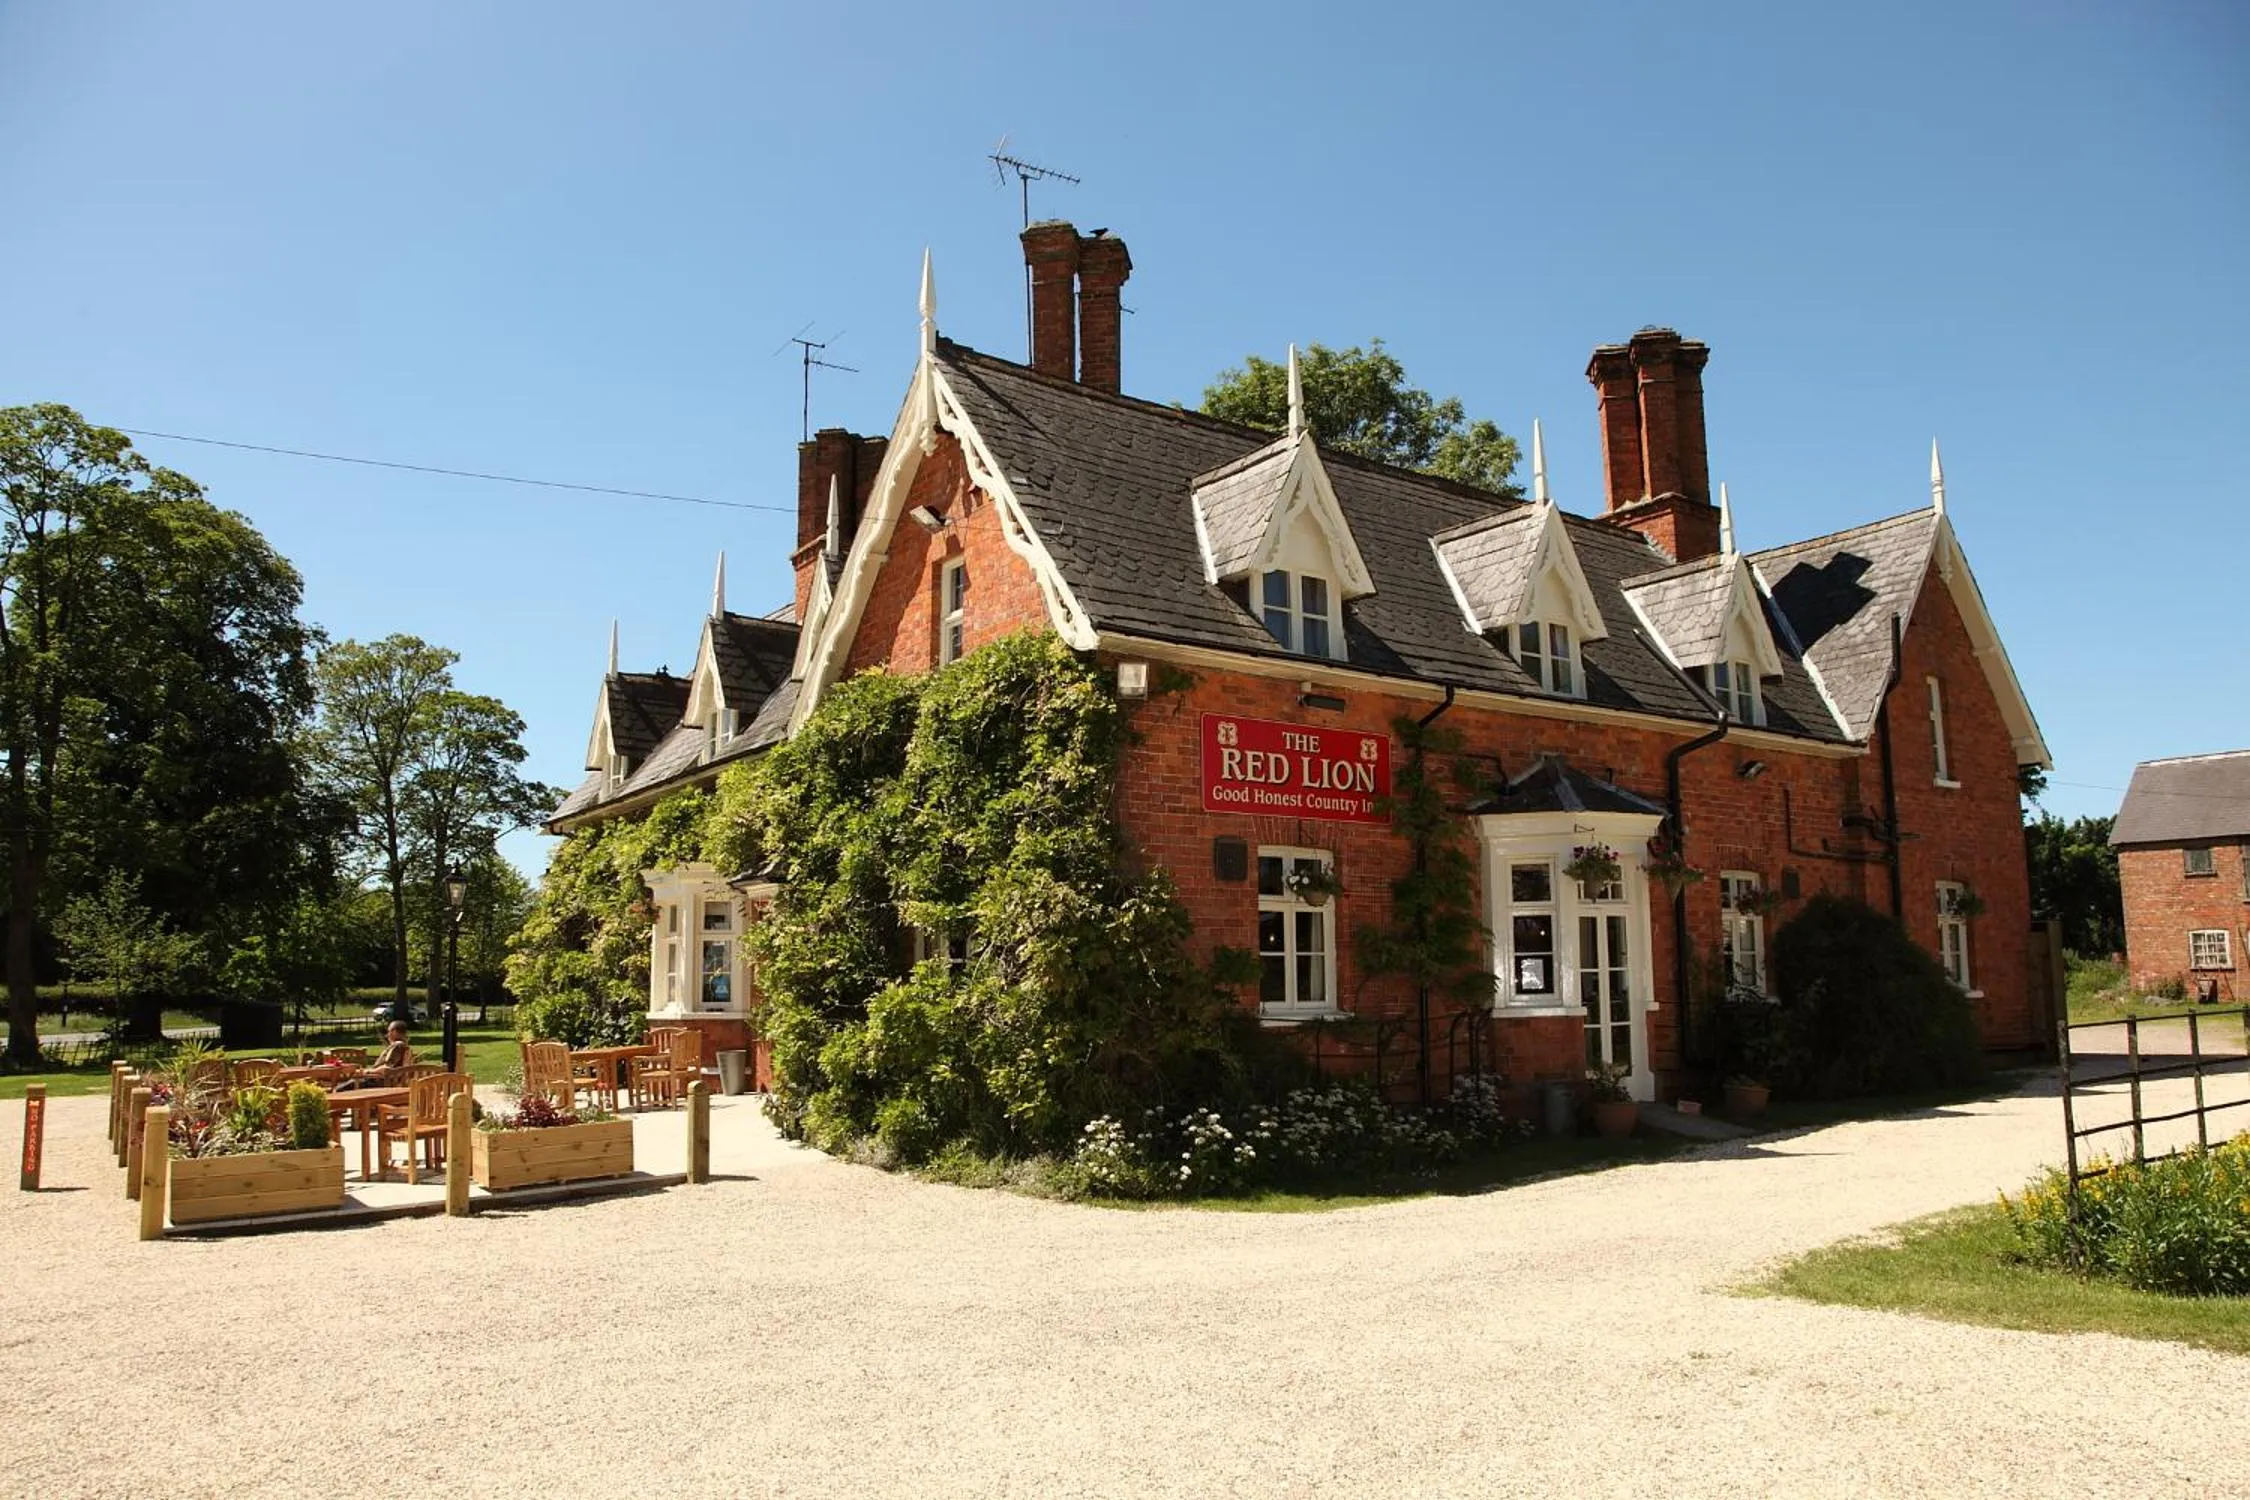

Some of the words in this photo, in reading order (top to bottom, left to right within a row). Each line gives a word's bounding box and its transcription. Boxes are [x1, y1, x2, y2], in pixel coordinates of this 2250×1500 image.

[1282, 732, 1320, 753] THE
[1221, 748, 1290, 784] RED
[1301, 757, 1376, 792] LION
[1213, 786, 1249, 802] Good
[1254, 789, 1304, 806] Honest
[1306, 794, 1358, 815] Country
